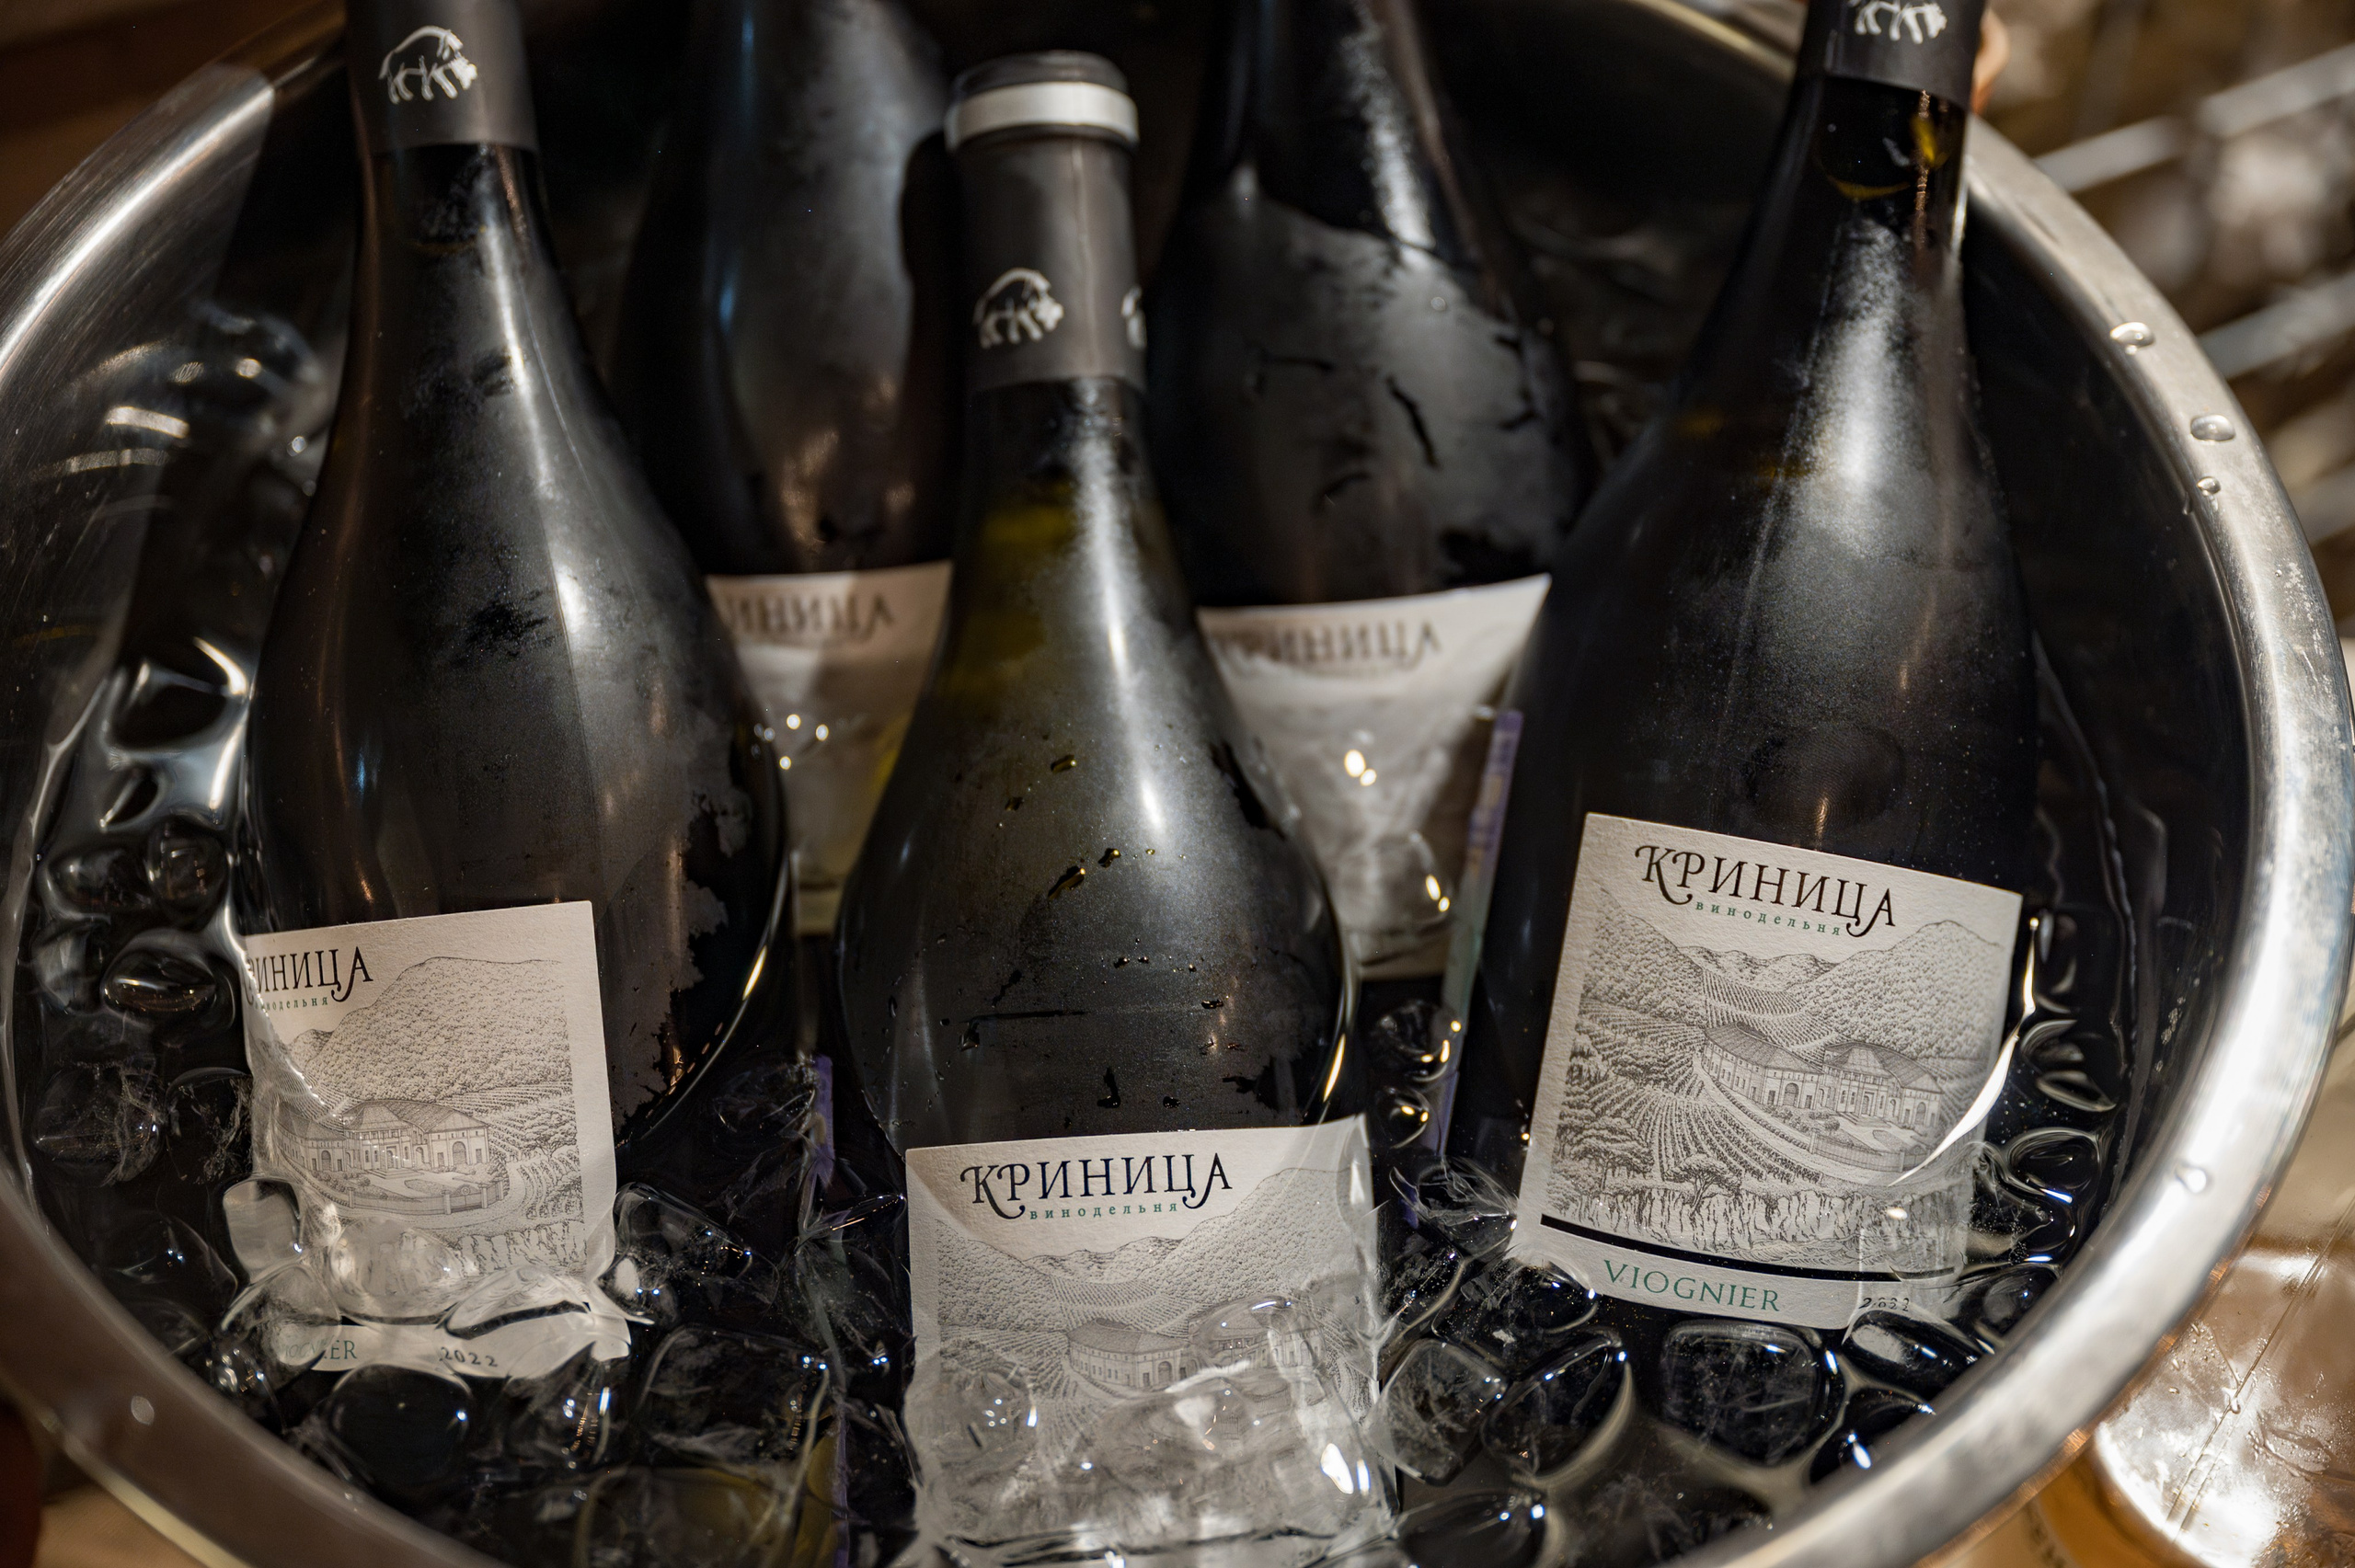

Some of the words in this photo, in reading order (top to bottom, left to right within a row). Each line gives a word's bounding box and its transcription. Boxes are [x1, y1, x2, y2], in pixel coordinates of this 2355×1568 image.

[1635, 845, 1896, 937] КРИНИЦА
[1695, 901, 1841, 936] винодельня
[959, 1152, 1234, 1220] КРИНИЦА
[1029, 1202, 1178, 1220] винодельня
[1604, 1260, 1779, 1312] VIOGNIER
[439, 1346, 499, 1368] 2022
